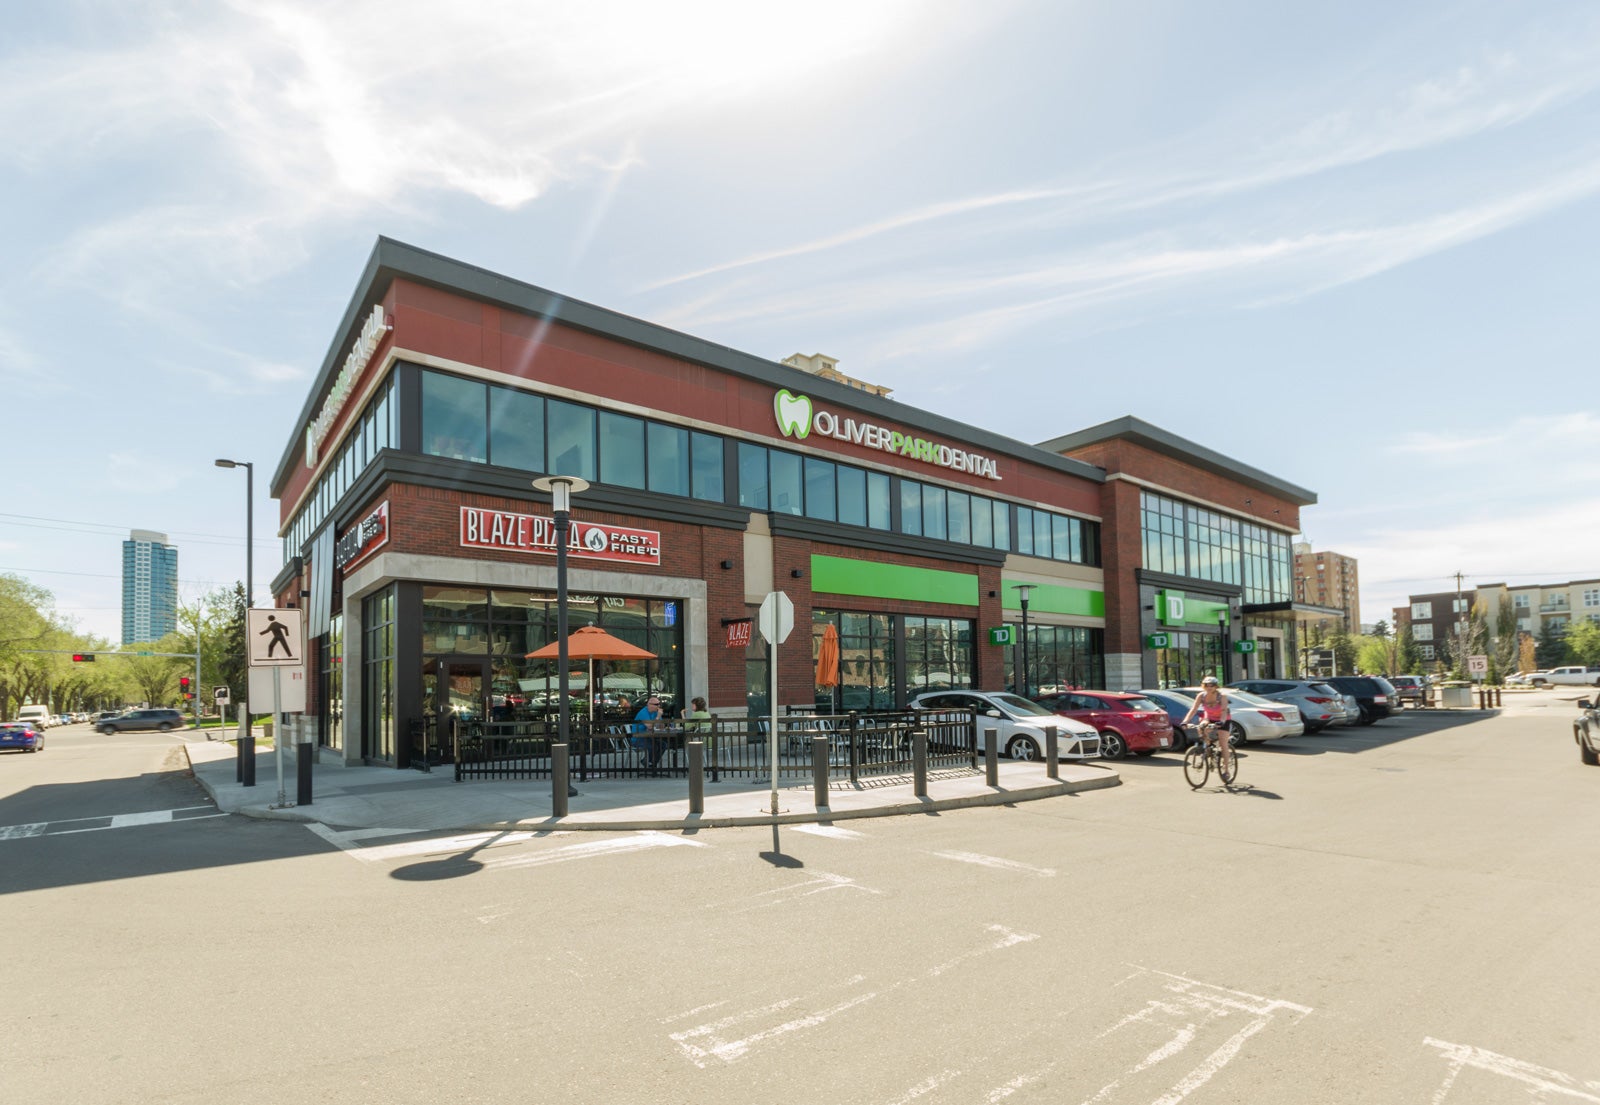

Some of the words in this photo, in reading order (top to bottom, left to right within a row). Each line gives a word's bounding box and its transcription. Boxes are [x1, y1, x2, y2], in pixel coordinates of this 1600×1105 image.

[467, 509, 526, 547] BLAZE
[533, 518, 581, 552] PIZA
[611, 532, 653, 545] FAST.
[611, 543, 659, 556] FIRE'D
[1167, 596, 1184, 620] TD
[729, 622, 749, 640] BLAZE
[993, 629, 1009, 642] TD
[1152, 635, 1167, 646] TD
[1238, 642, 1253, 651] TD
[1472, 661, 1484, 670] 15
